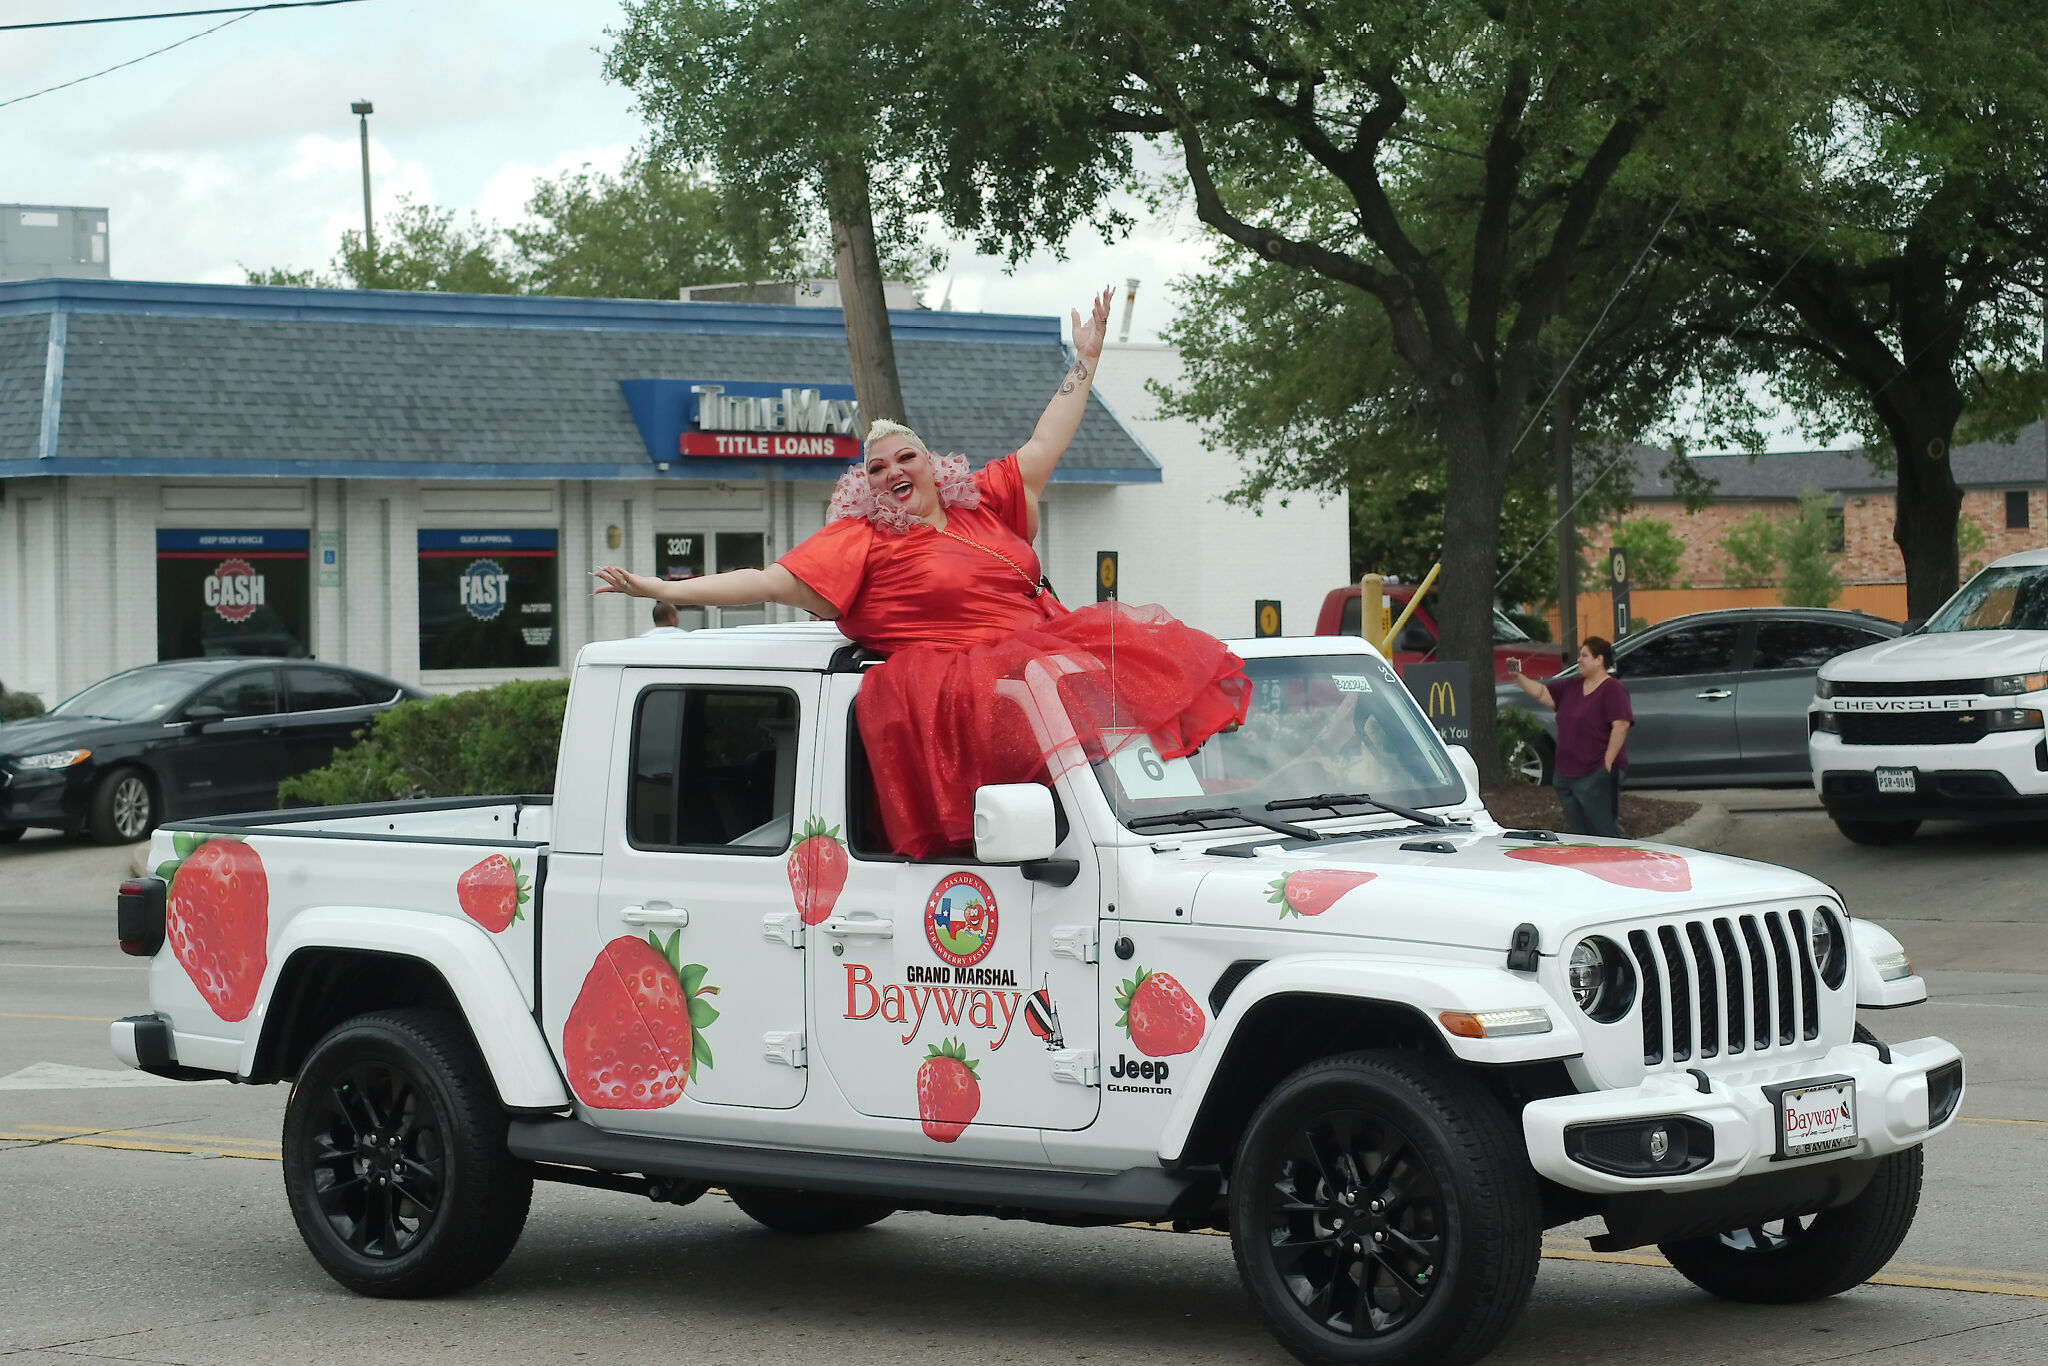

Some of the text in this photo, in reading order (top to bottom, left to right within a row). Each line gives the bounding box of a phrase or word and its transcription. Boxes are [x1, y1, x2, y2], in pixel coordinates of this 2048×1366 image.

[716, 436, 835, 455] TITLE LOANS
[200, 536, 263, 544] KEEP YOUR VEHICLE
[667, 539, 692, 556] 3207
[204, 575, 265, 606] CASH
[460, 574, 509, 605] FAST
[1834, 698, 1978, 711] CHEVROLET
[1449, 727, 1468, 739] You
[1137, 746, 1165, 782] 6
[944, 876, 983, 892] PASADENA
[928, 925, 994, 965] STRAWBERRY FESTIVAL
[907, 966, 1018, 987] GRAND MARSHAL
[843, 963, 1022, 1051] Bayway
[1110, 1054, 1169, 1085] Jeep
[1107, 1084, 1172, 1095] GLADIATOR
[1785, 1107, 1839, 1137] Bayway
[1804, 1139, 1842, 1152] BAYWAY
